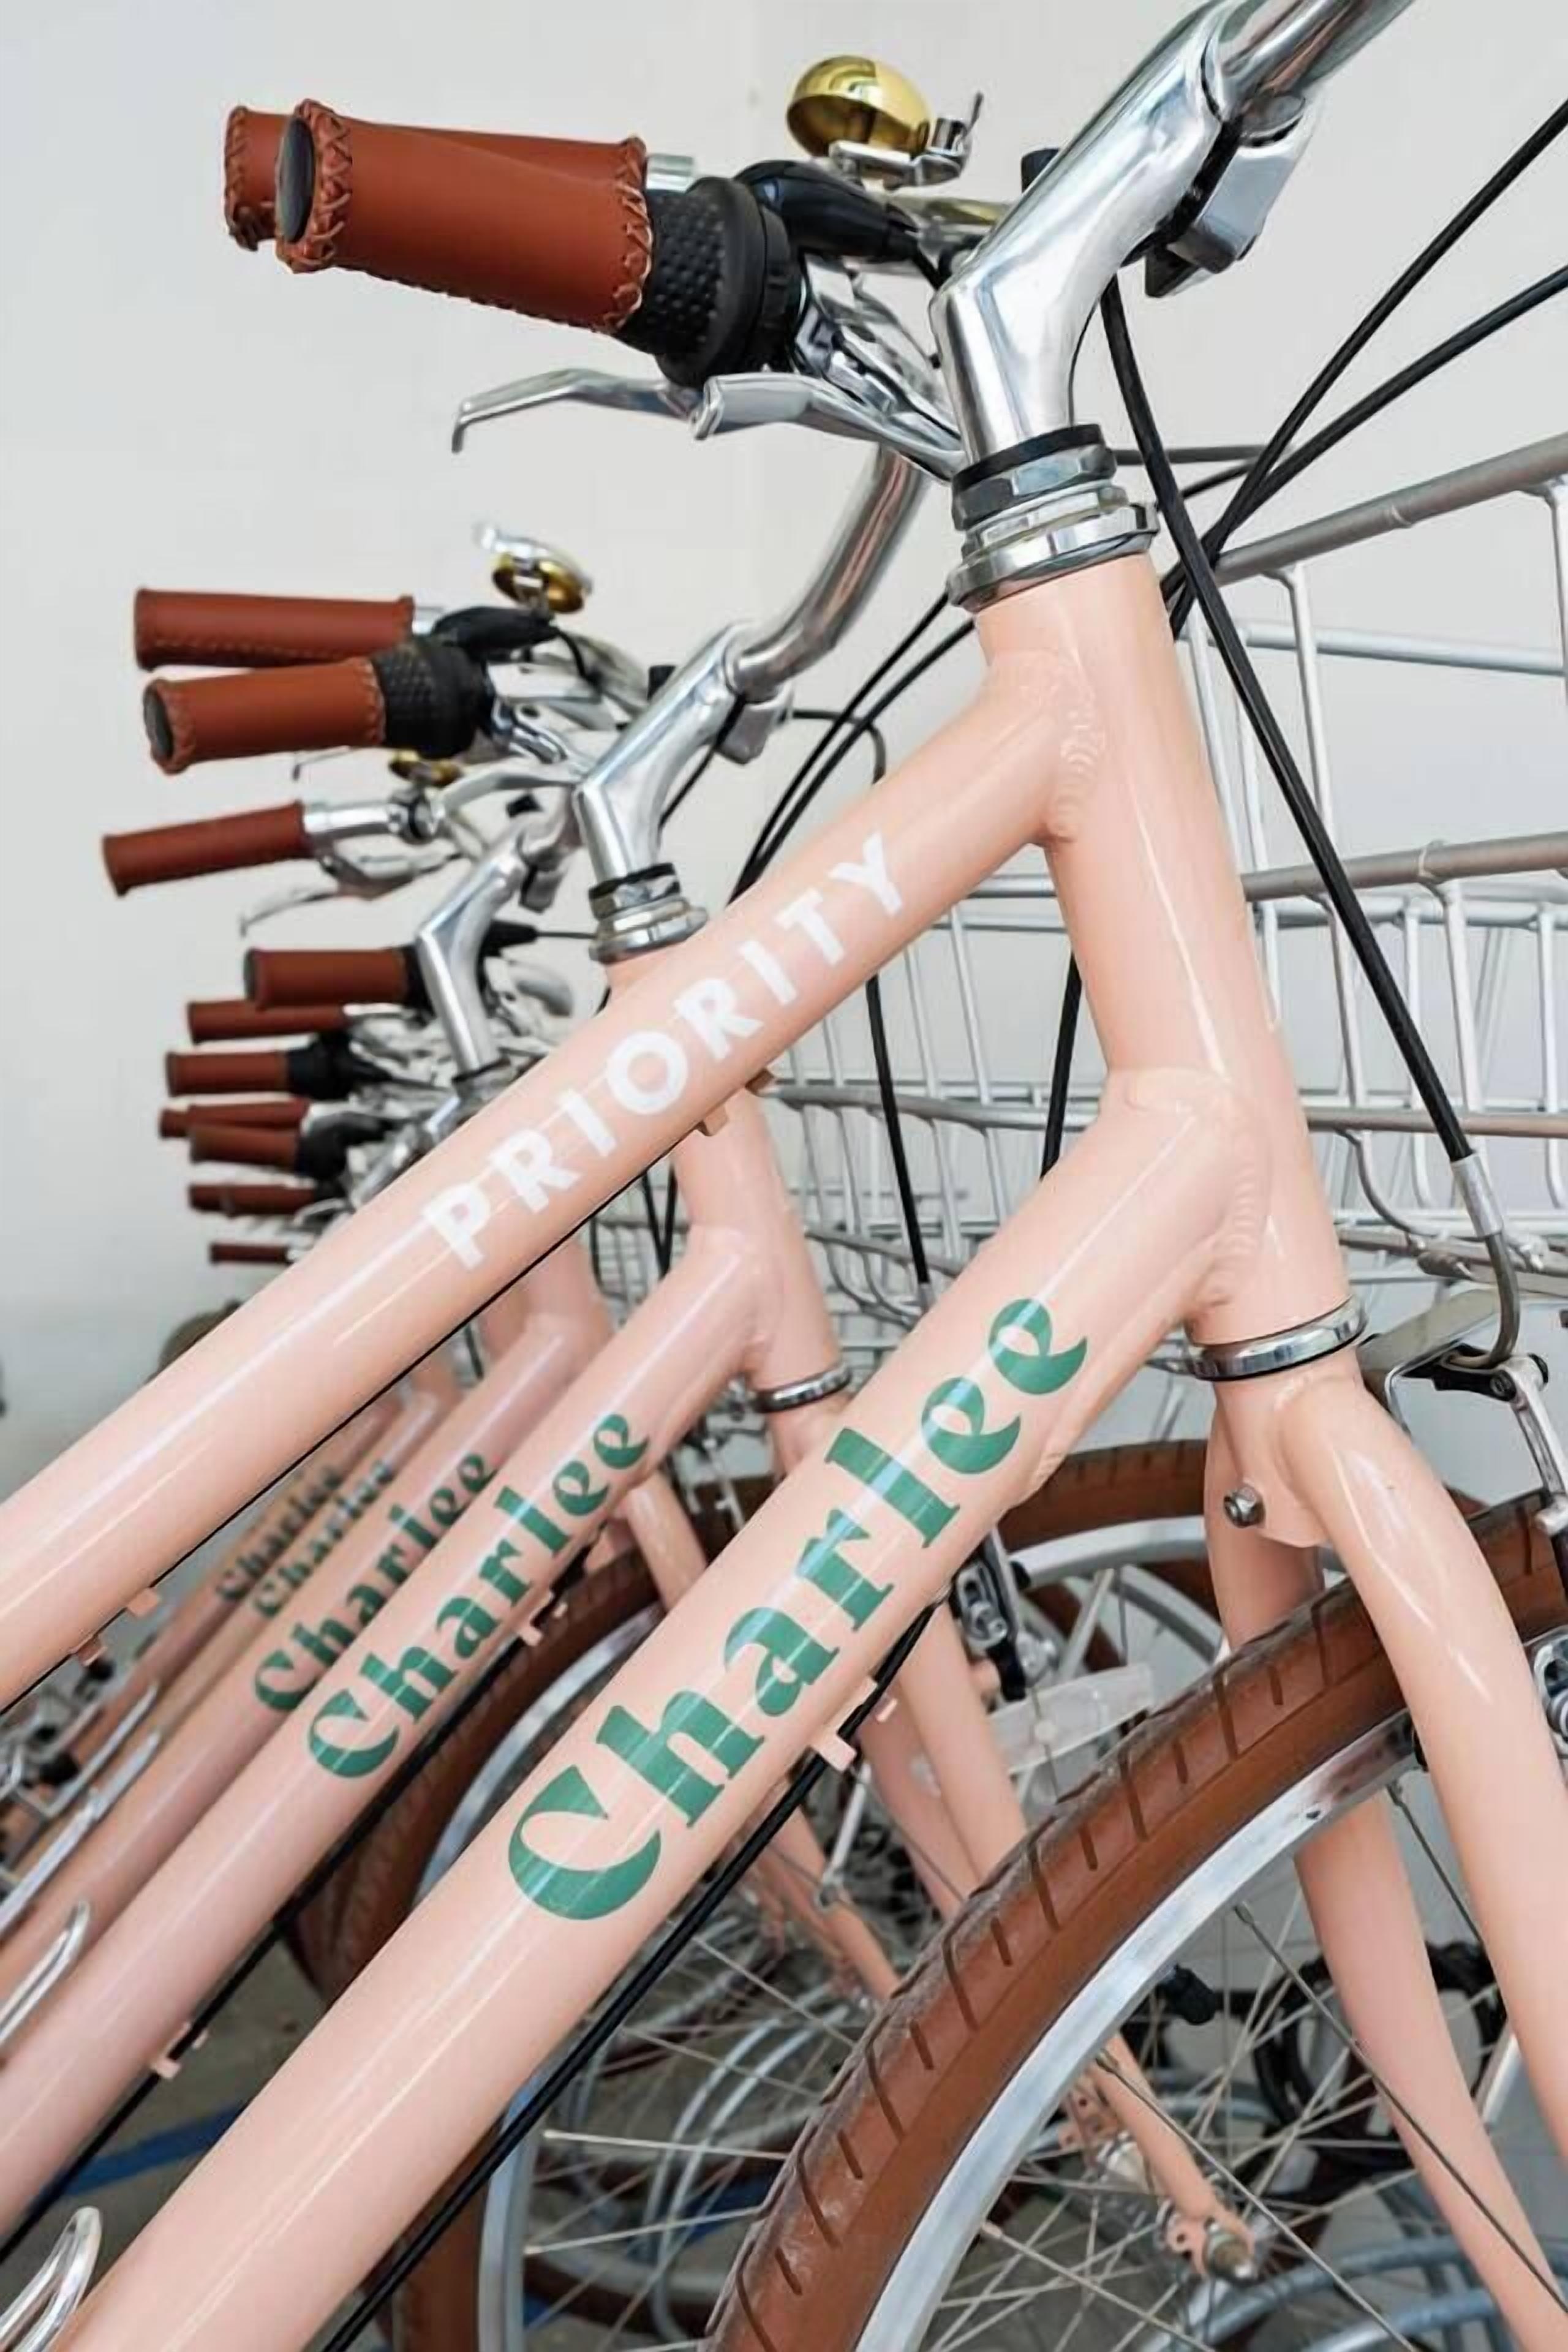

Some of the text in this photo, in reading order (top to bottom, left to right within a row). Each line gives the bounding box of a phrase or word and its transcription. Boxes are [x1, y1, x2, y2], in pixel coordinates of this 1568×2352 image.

[423, 831, 902, 1270] PRIORITY
[254, 1453, 497, 1710] Charlee
[309, 1414, 650, 1777] Charlee
[508, 1298, 1088, 1920] Charlee
